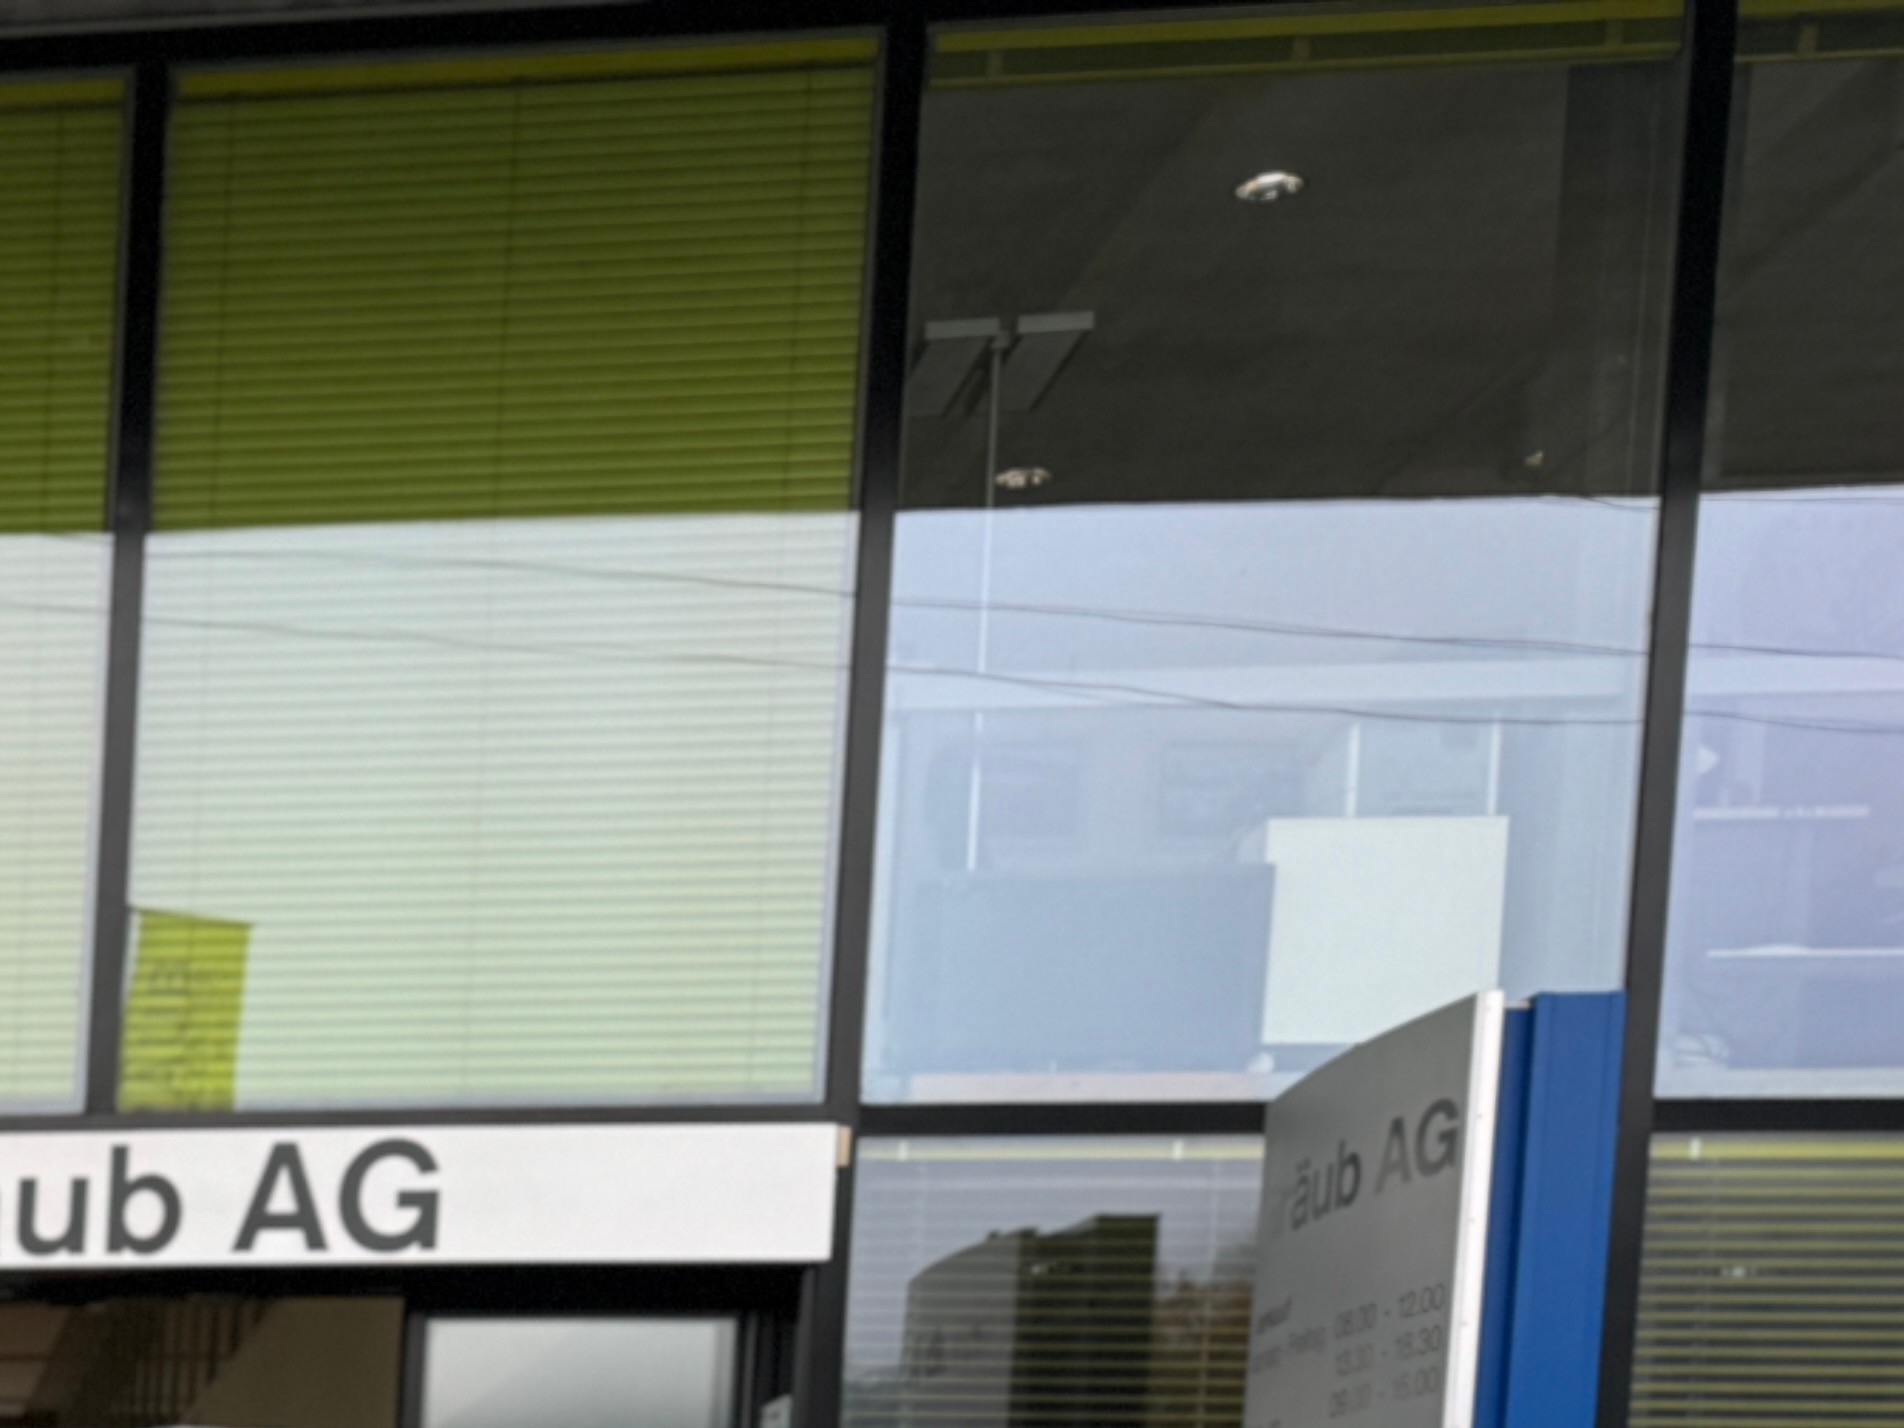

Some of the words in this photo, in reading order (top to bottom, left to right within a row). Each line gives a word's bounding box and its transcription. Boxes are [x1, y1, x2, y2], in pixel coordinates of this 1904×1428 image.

[1375, 1097, 1459, 1193] AG
[233, 1137, 442, 1256] AG
[1396, 1281, 1445, 1318] 12.00
